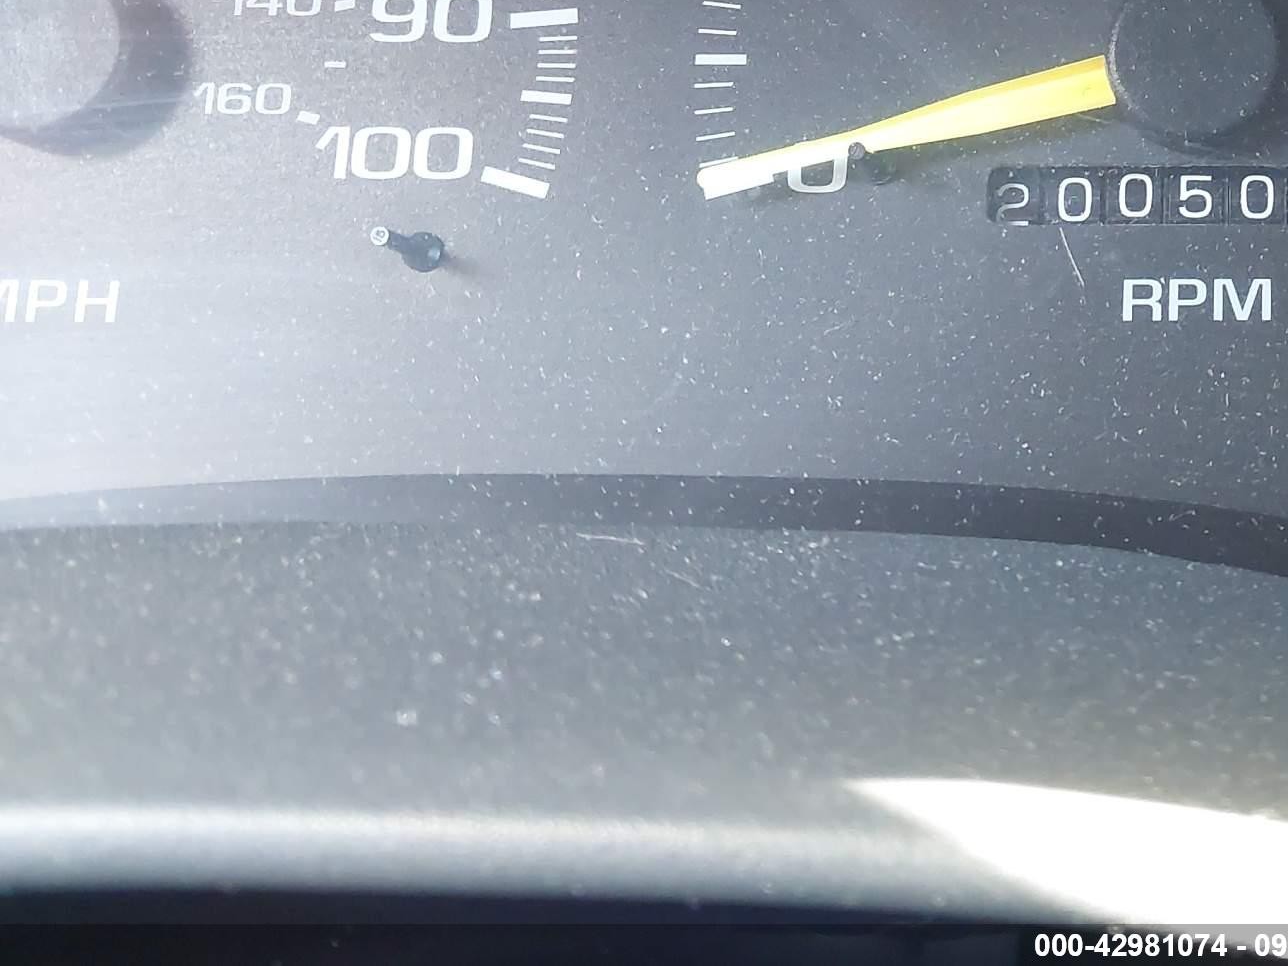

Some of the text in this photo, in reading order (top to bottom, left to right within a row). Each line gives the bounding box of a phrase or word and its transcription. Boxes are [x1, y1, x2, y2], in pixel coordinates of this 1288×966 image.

[195, 82, 292, 115] 160
[315, 126, 474, 180] 100
[1120, 278, 1273, 323] RPM
